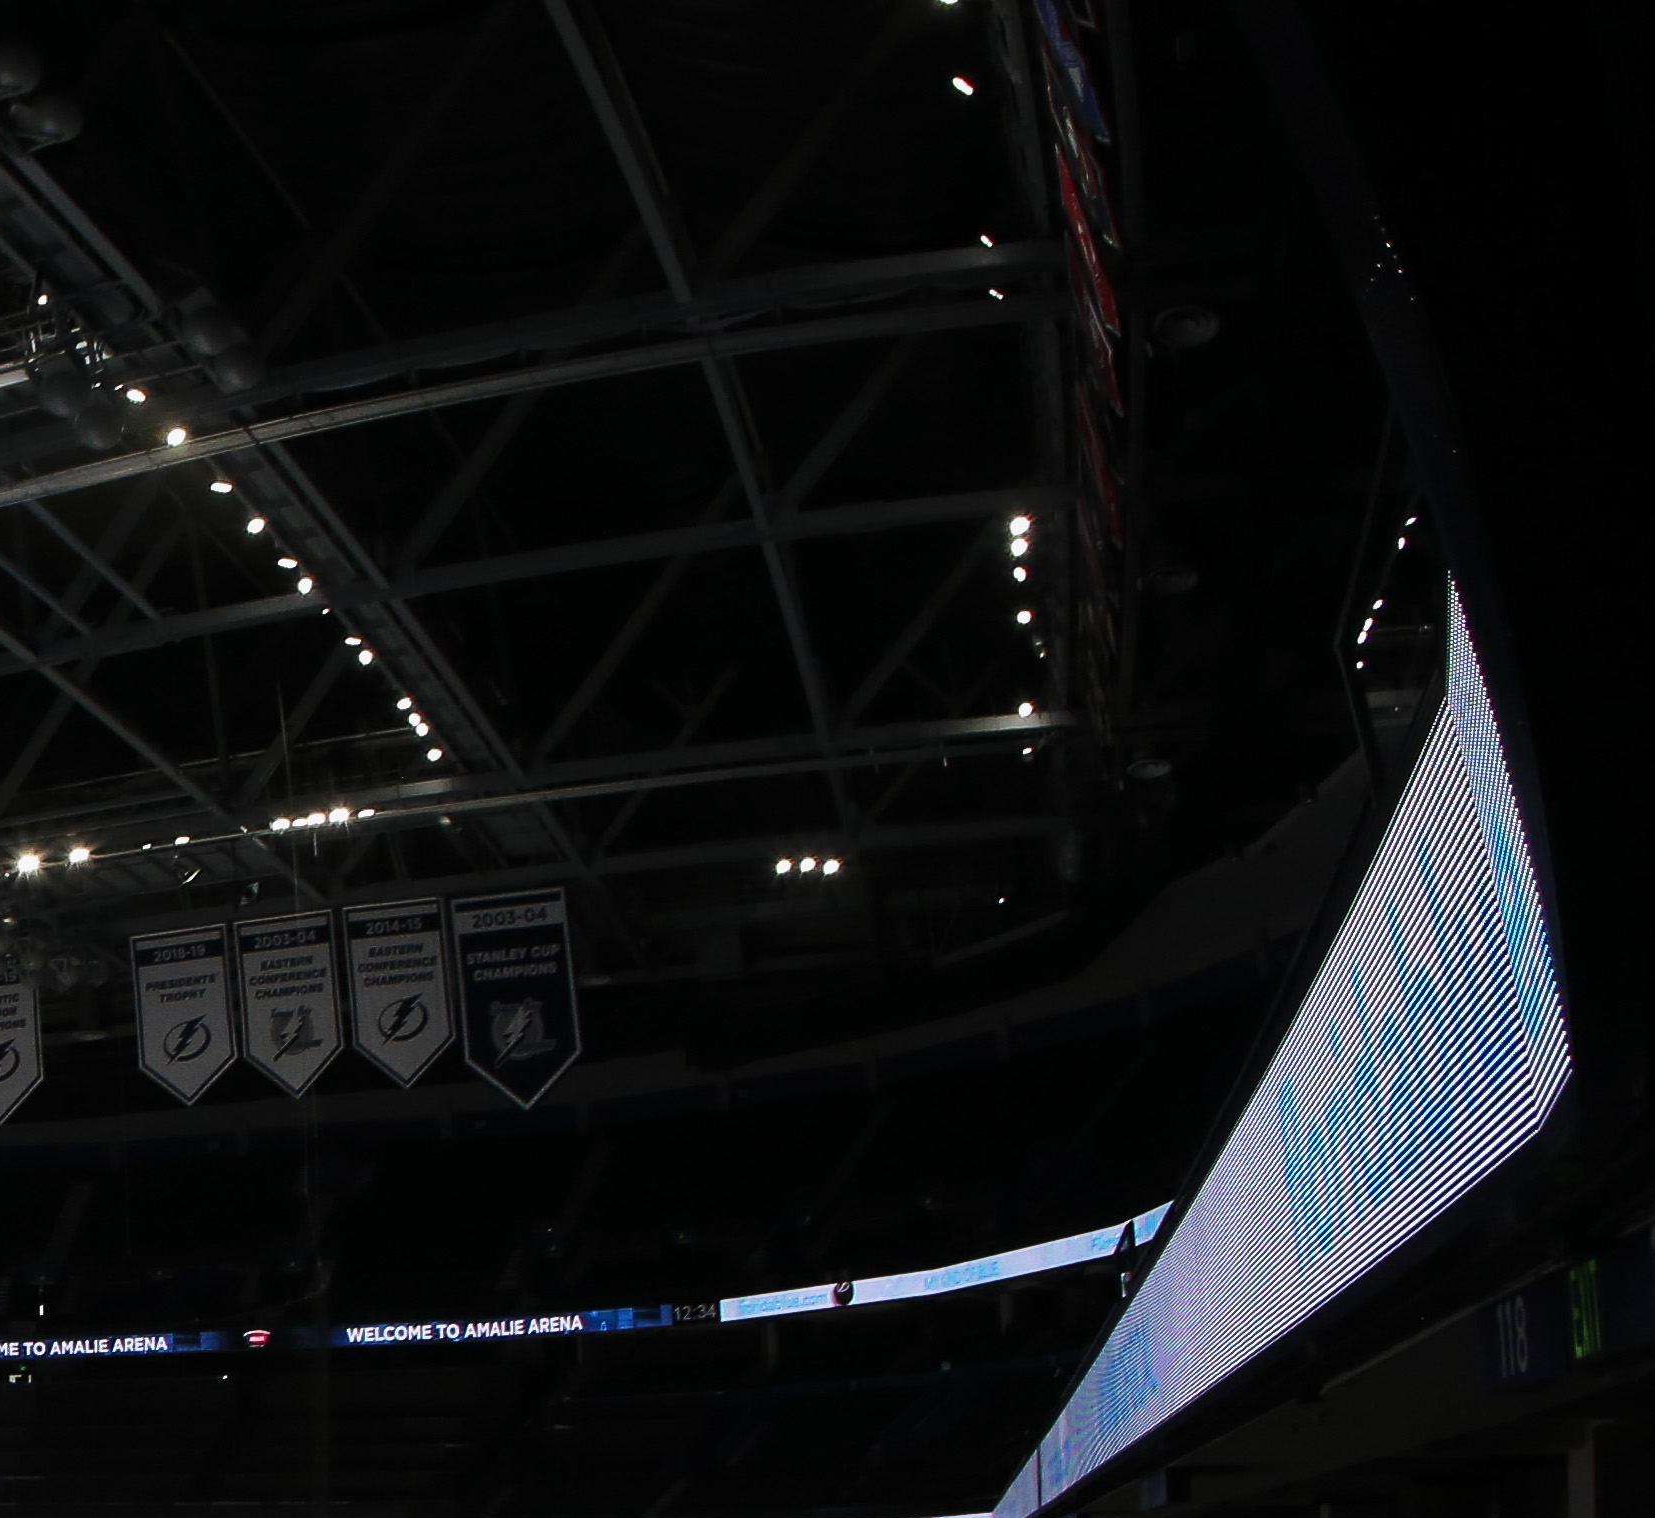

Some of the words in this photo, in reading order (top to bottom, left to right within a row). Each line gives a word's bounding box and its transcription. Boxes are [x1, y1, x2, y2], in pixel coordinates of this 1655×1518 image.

[365, 917, 424, 936] 2014-15
[470, 908, 548, 929] 2003-04
[252, 929, 317, 950] 2003-04
[153, 943, 208, 963] 2018-19
[367, 942, 425, 958] EASTERN
[466, 946, 533, 966] STANLEY
[534, 943, 562, 960] CUP
[260, 955, 314, 972] EASTERN
[356, 955, 438, 974] CONFERENCE
[474, 962, 559, 982] CHAMPIONS
[250, 968, 328, 987] CONFERENCE
[363, 970, 435, 987] CHAMPIONS
[158, 987, 206, 1004] TROPHY
[254, 983, 324, 1001] CHAMPIONS
[673, 1304, 717, 1320] 12:34
[1567, 1257, 1603, 1360] EXIT
[346, 1322, 432, 1343] WELCOME
[435, 1321, 461, 1340] TO
[464, 1319, 526, 1338] AMALIE
[528, 1314, 584, 1333] ARENA
[1496, 1293, 1530, 1378] 118
[22, 1341, 46, 1357] TO
[50, 1339, 109, 1355] AMALIE
[111, 1337, 168, 1353] ARENA
